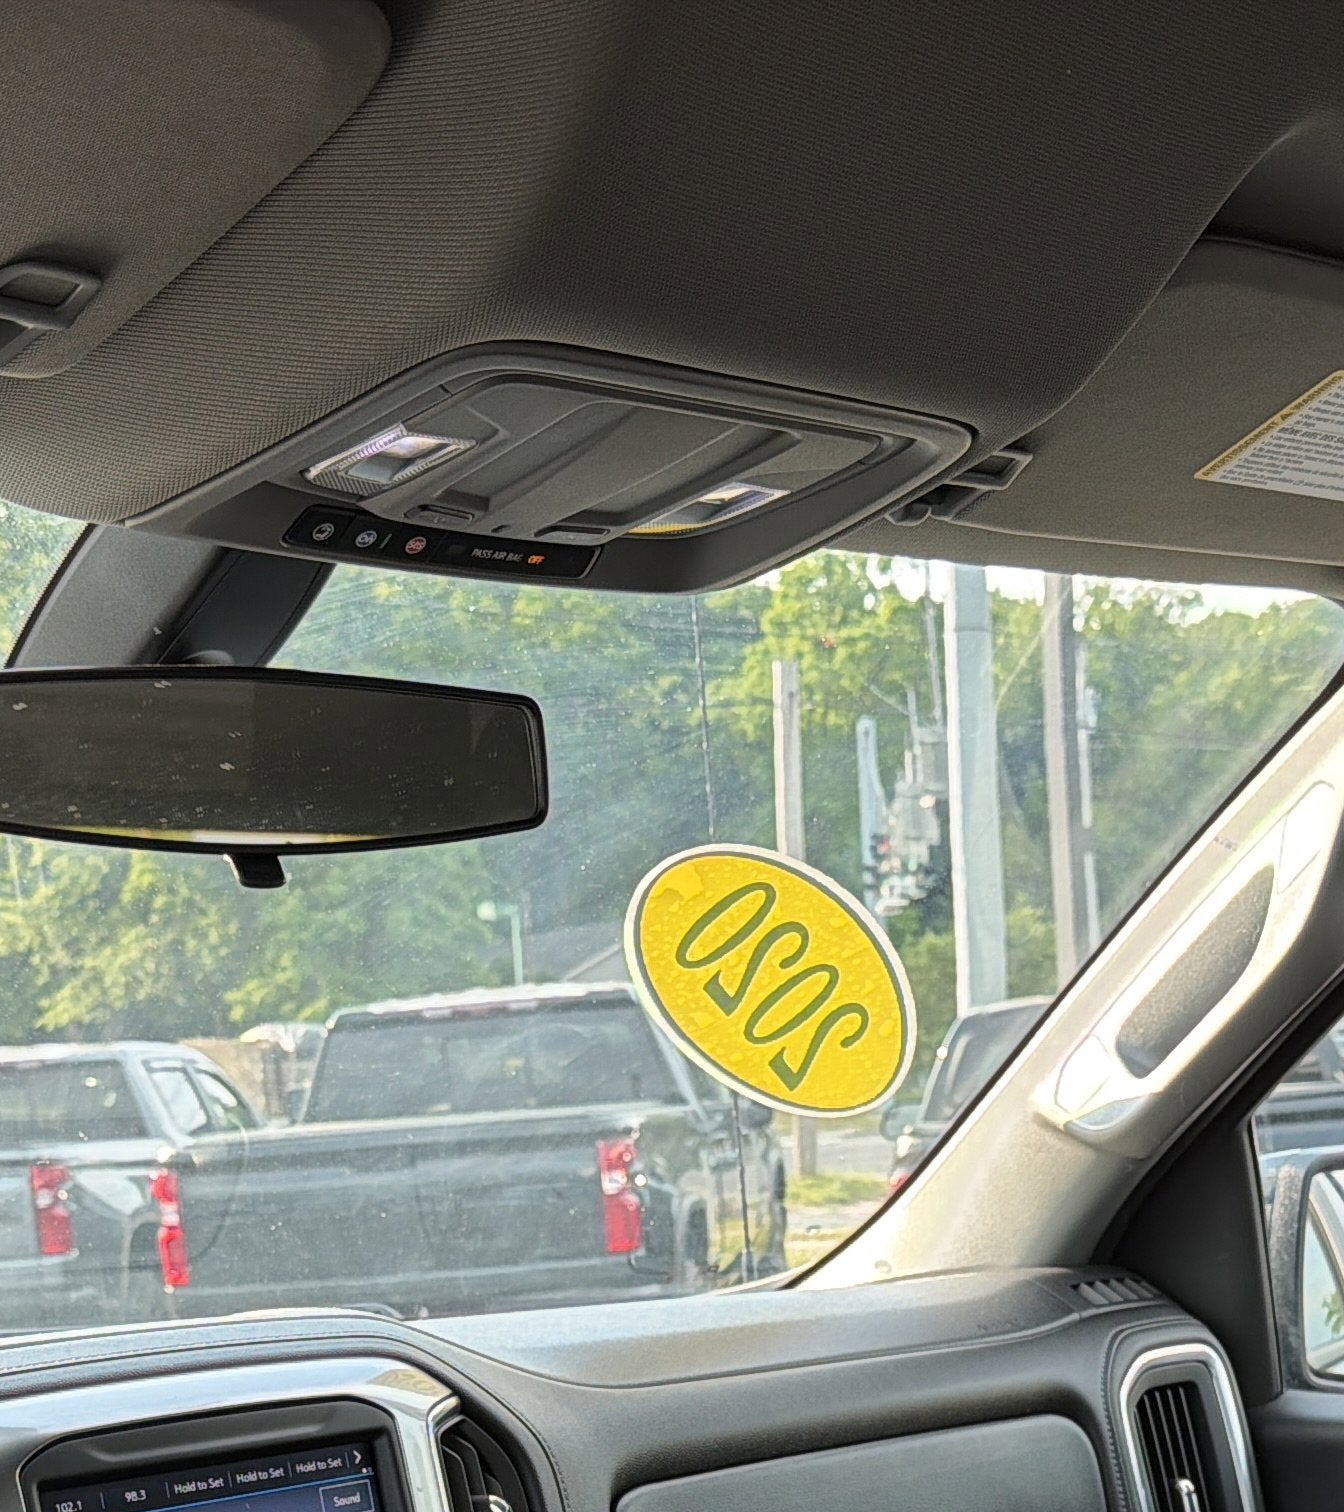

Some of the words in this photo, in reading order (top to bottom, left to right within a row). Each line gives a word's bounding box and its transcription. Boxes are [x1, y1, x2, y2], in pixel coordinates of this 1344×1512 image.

[471, 548, 493, 559] PASS
[295, 1461, 317, 1474] Hold
[317, 1460, 327, 1470] to
[327, 1457, 342, 1469] Set
[236, 1471, 257, 1484] Hold
[258, 1470, 268, 1480] to
[269, 1467, 285, 1479] Set
[174, 1480, 196, 1494] Hold
[197, 1479, 208, 1490] to
[208, 1477, 224, 1489] Set
[124, 1490, 147, 1503] 98.3
[333, 1492, 361, 1507] Sound
